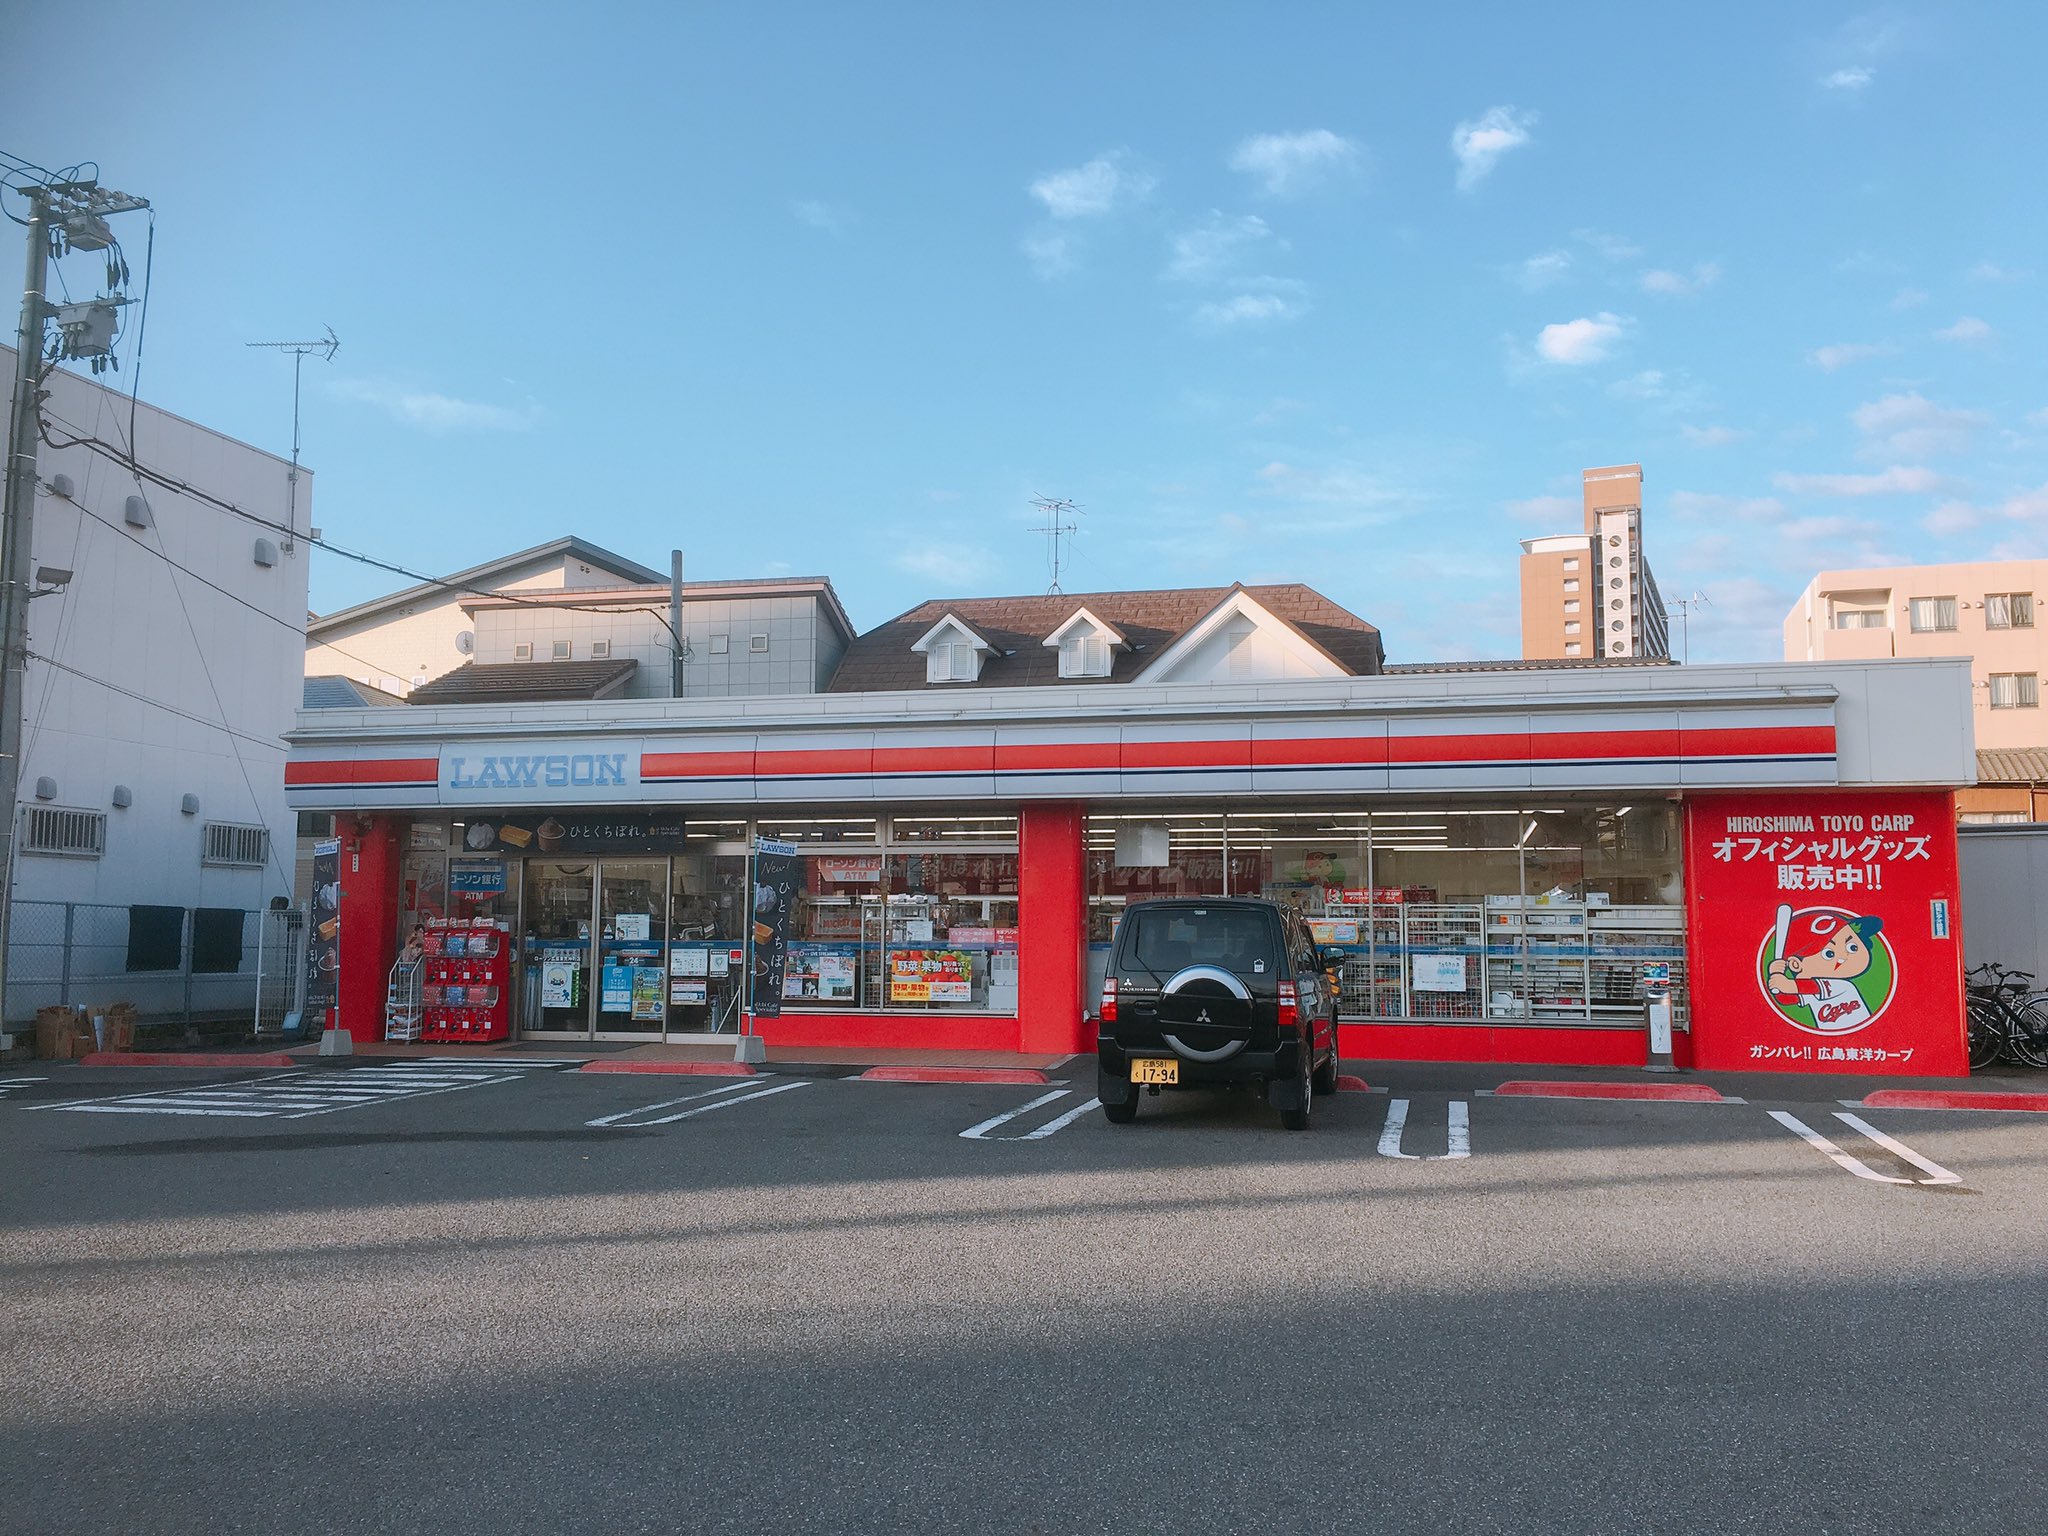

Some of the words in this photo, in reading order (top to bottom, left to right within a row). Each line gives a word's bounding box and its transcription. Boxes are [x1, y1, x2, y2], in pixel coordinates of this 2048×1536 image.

[451, 753, 628, 788] LAWSON
[570, 825, 647, 839] ひとくちぼれ。
[1726, 816, 1814, 833] HIROSHIMA
[1821, 816, 1863, 832] TOYO
[1871, 814, 1914, 832] CARP
[761, 843, 795, 854] LAWSON
[1712, 835, 1932, 862] オフィシャルグッズ
[844, 871, 868, 880] ATM
[1777, 864, 1882, 890] 販売中!!
[464, 892, 484, 900] ATM
[1818, 1001, 1861, 1023] Carp
[1750, 1045, 1812, 1060] ガンバレ!!
[1817, 1047, 1914, 1062] 広島東洋カープ
[1143, 1068, 1176, 1082] 17-94
